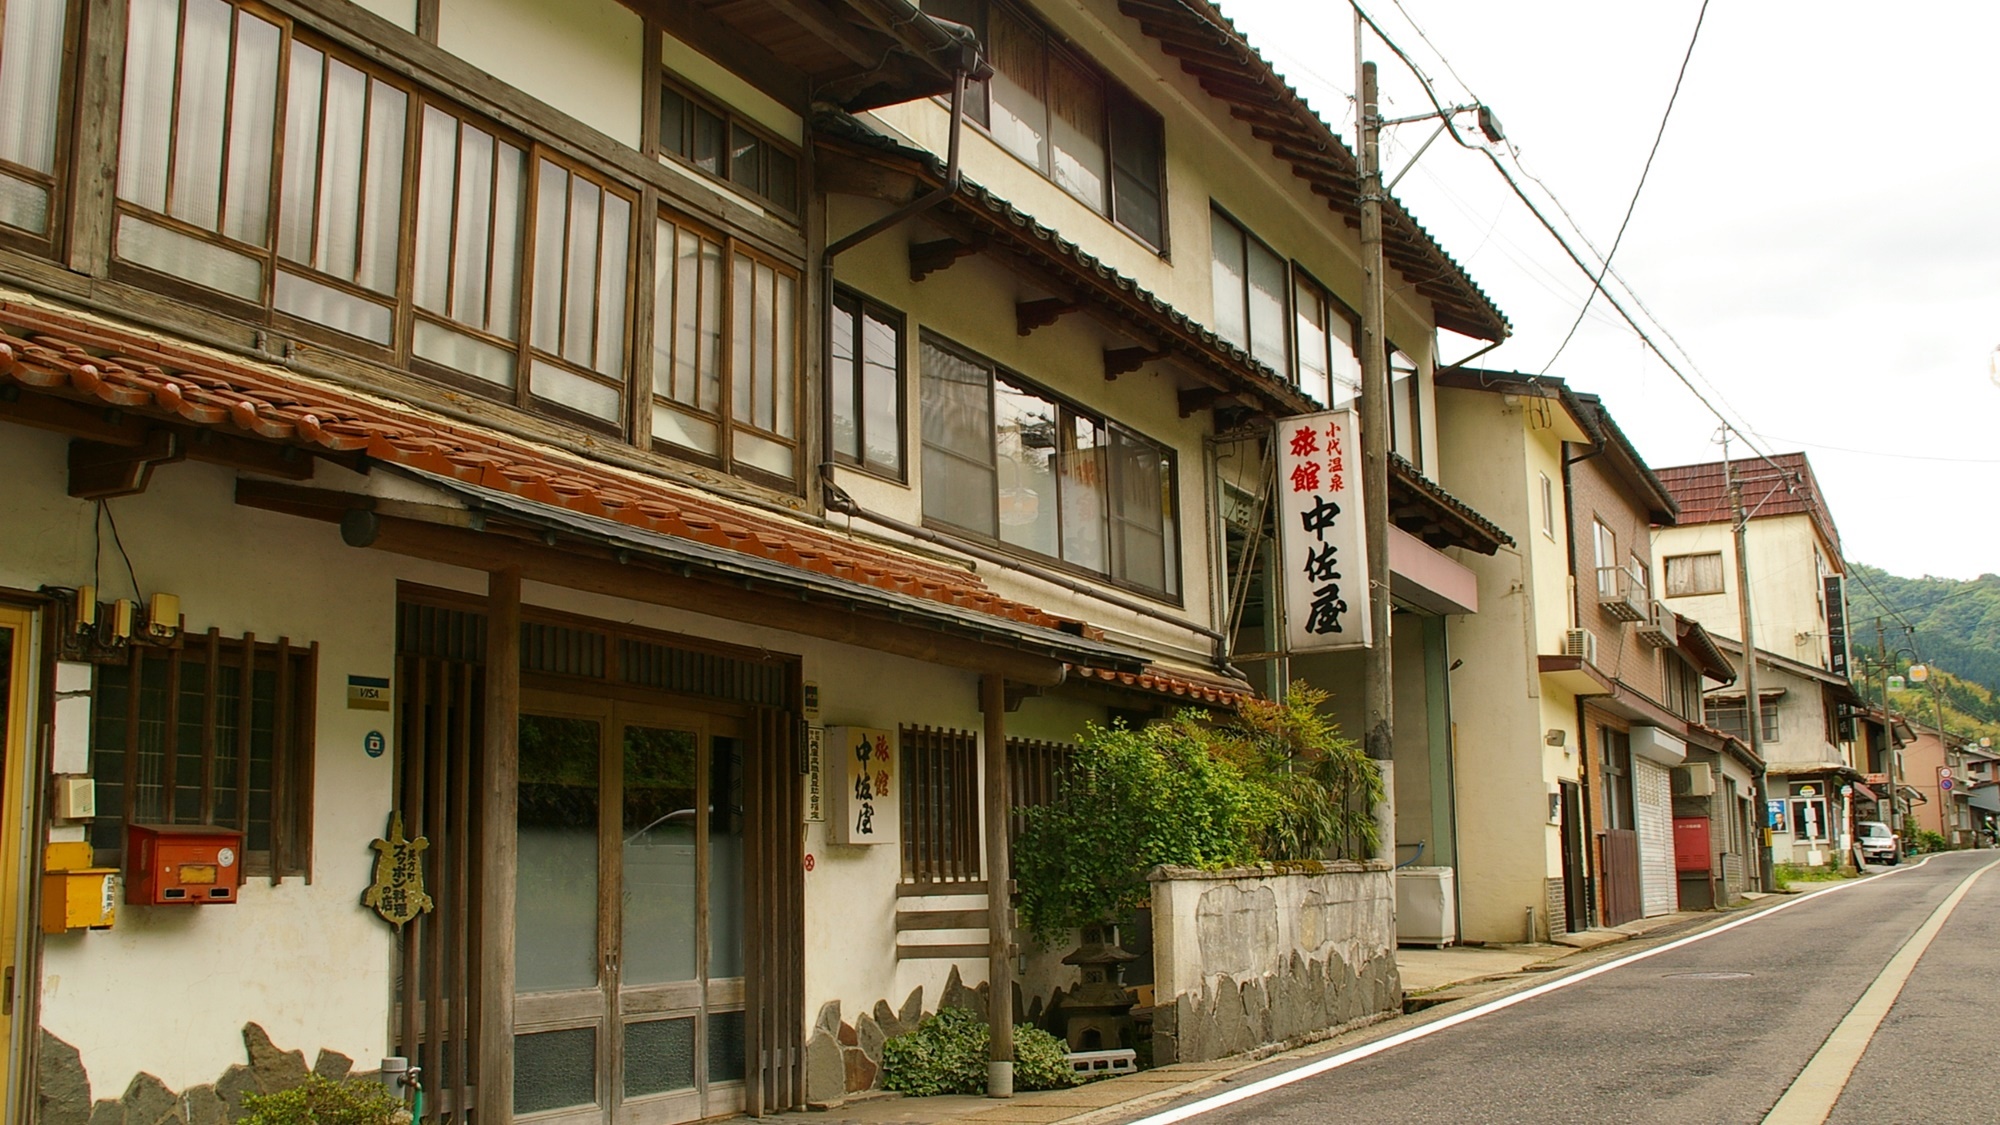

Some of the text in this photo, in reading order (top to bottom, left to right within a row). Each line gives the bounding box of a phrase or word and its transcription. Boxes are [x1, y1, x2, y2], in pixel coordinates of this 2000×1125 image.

[1289, 425, 1321, 493] 旅館
[1325, 421, 1345, 493] 小代温泉
[1300, 494, 1348, 635] 中佐屋
[359, 687, 380, 699] VISA
[855, 732, 875, 835] 中佐屋
[874, 735, 890, 797] 旅館
[382, 886, 393, 911] の店
[392, 843, 408, 918] スッポン料理
